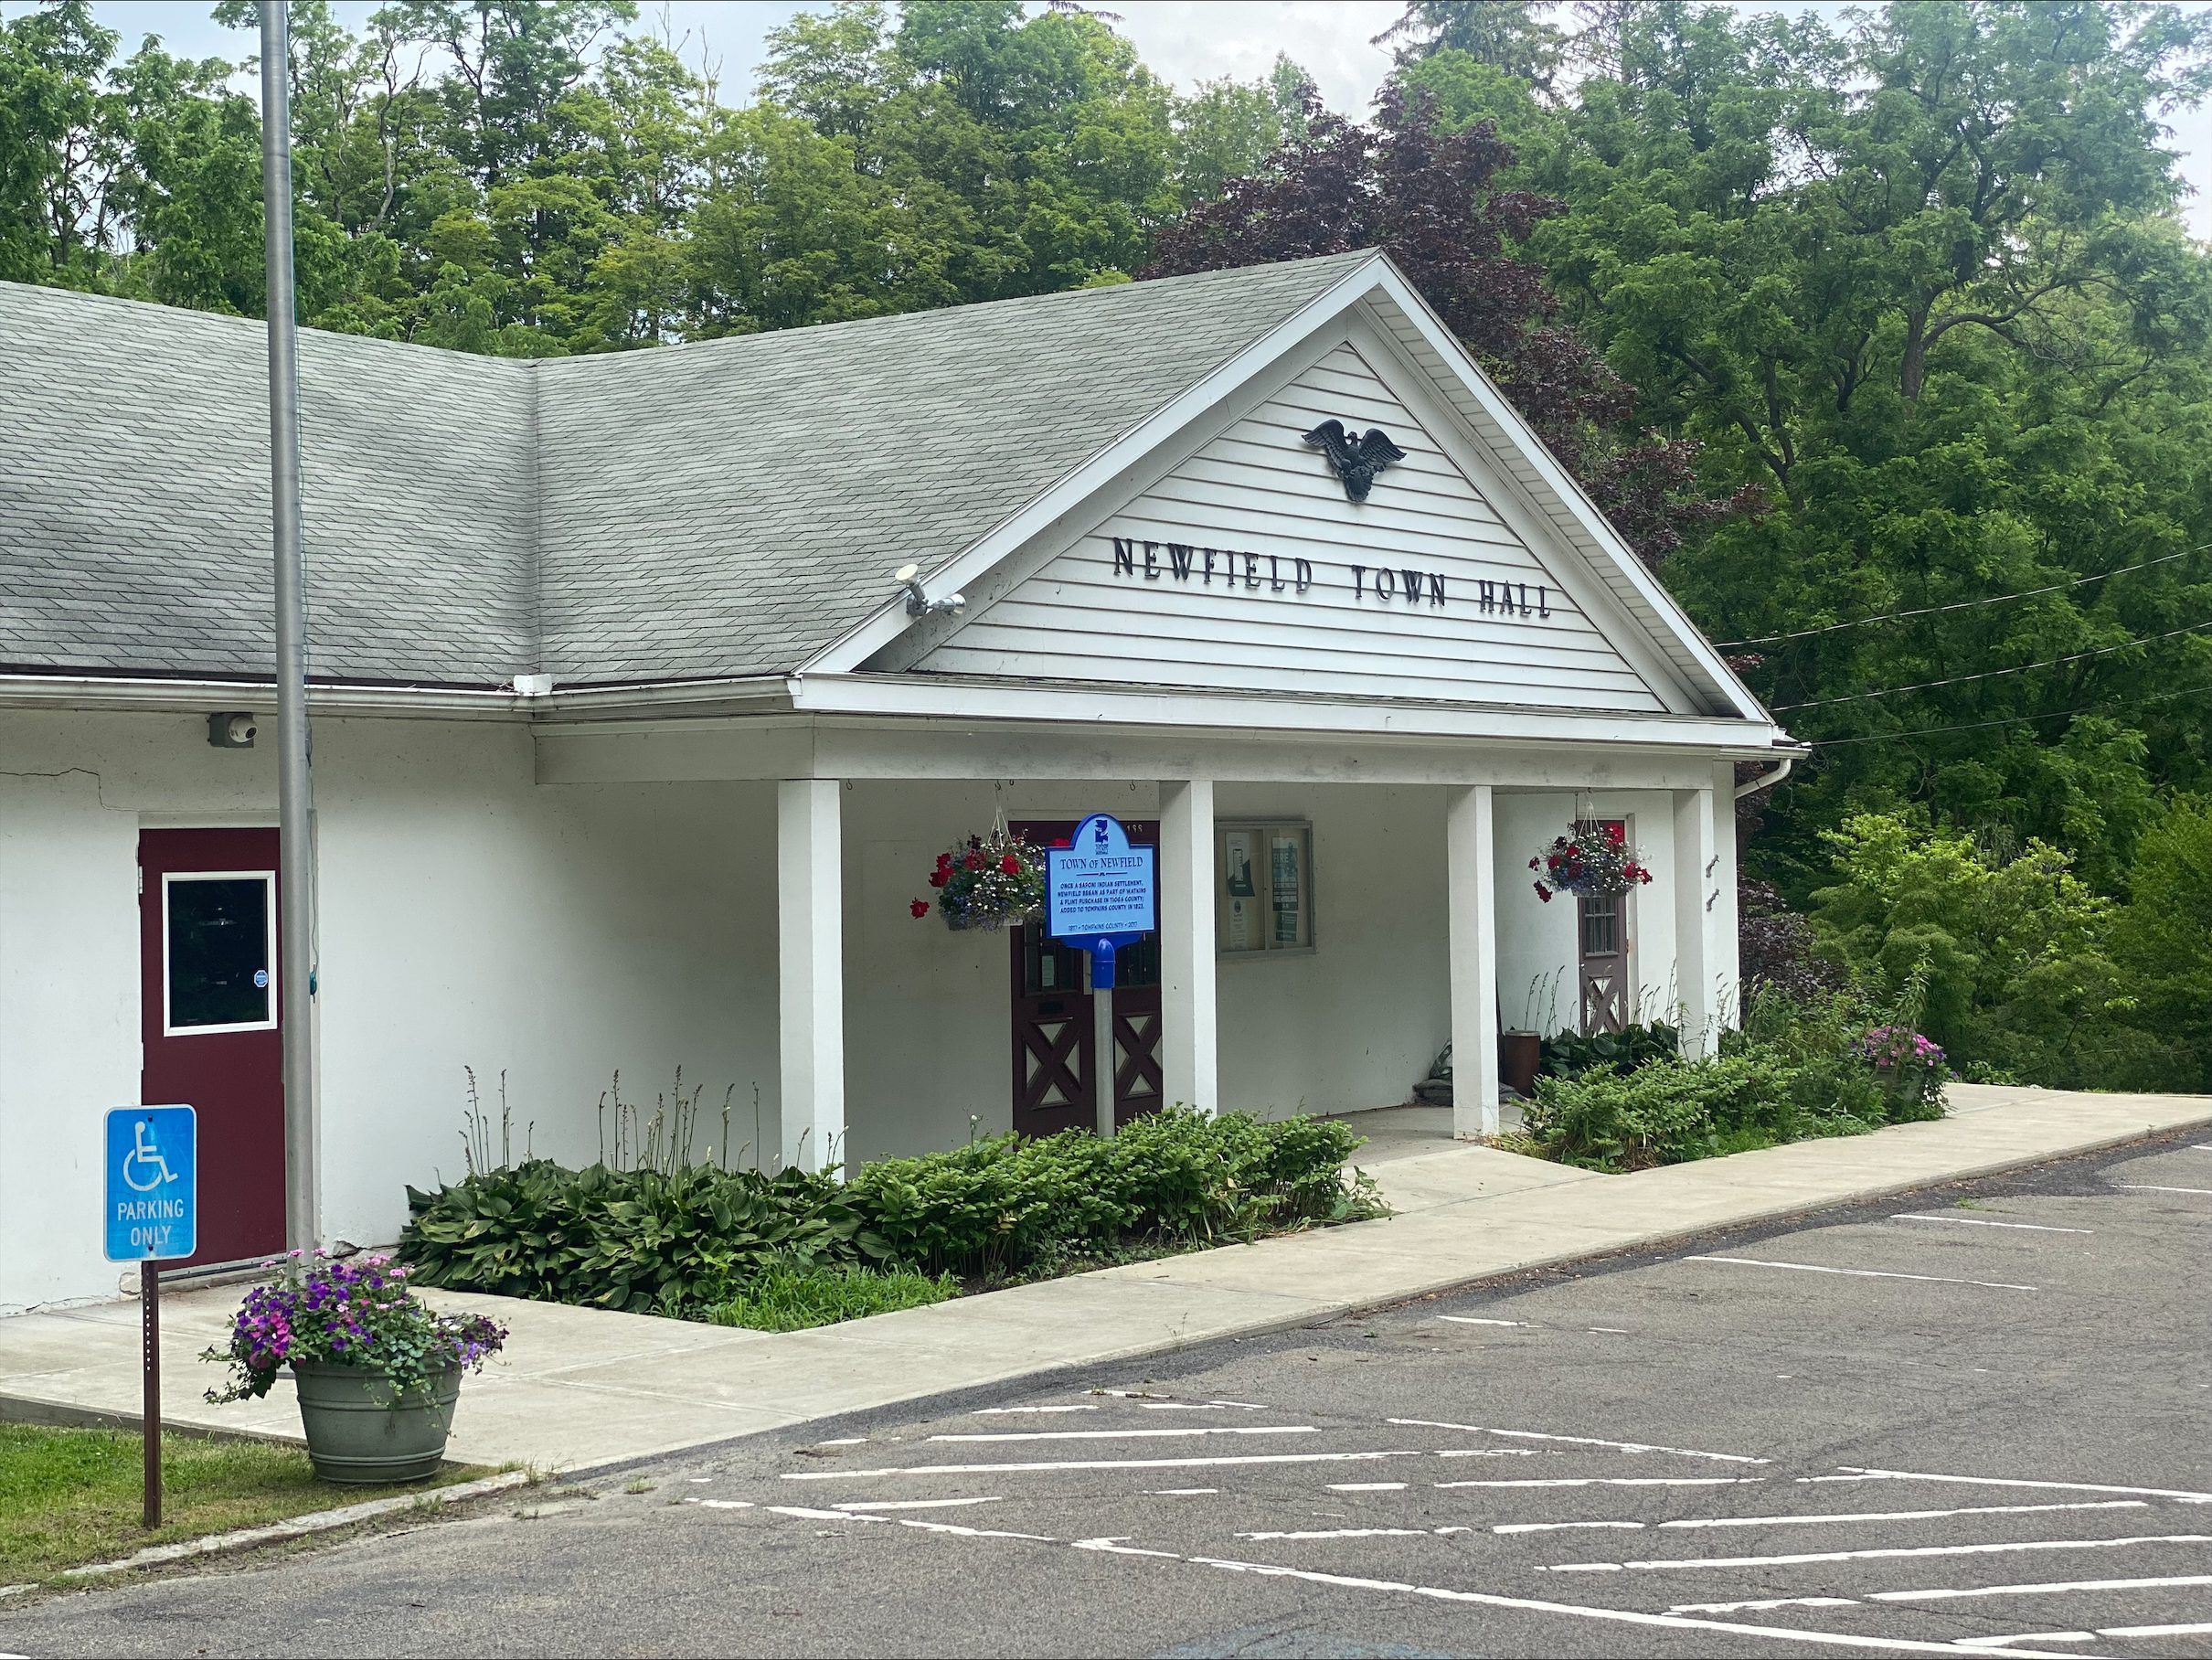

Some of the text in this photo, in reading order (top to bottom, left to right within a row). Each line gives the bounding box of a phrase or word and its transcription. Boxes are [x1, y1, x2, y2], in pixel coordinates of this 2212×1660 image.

[1112, 537, 1551, 619] NEWFIELD TOWN HALL
[1060, 856, 1143, 869] TOWN OF NEWFIELD
[117, 1198, 184, 1221] PARKING
[130, 1225, 172, 1247] ONLY
